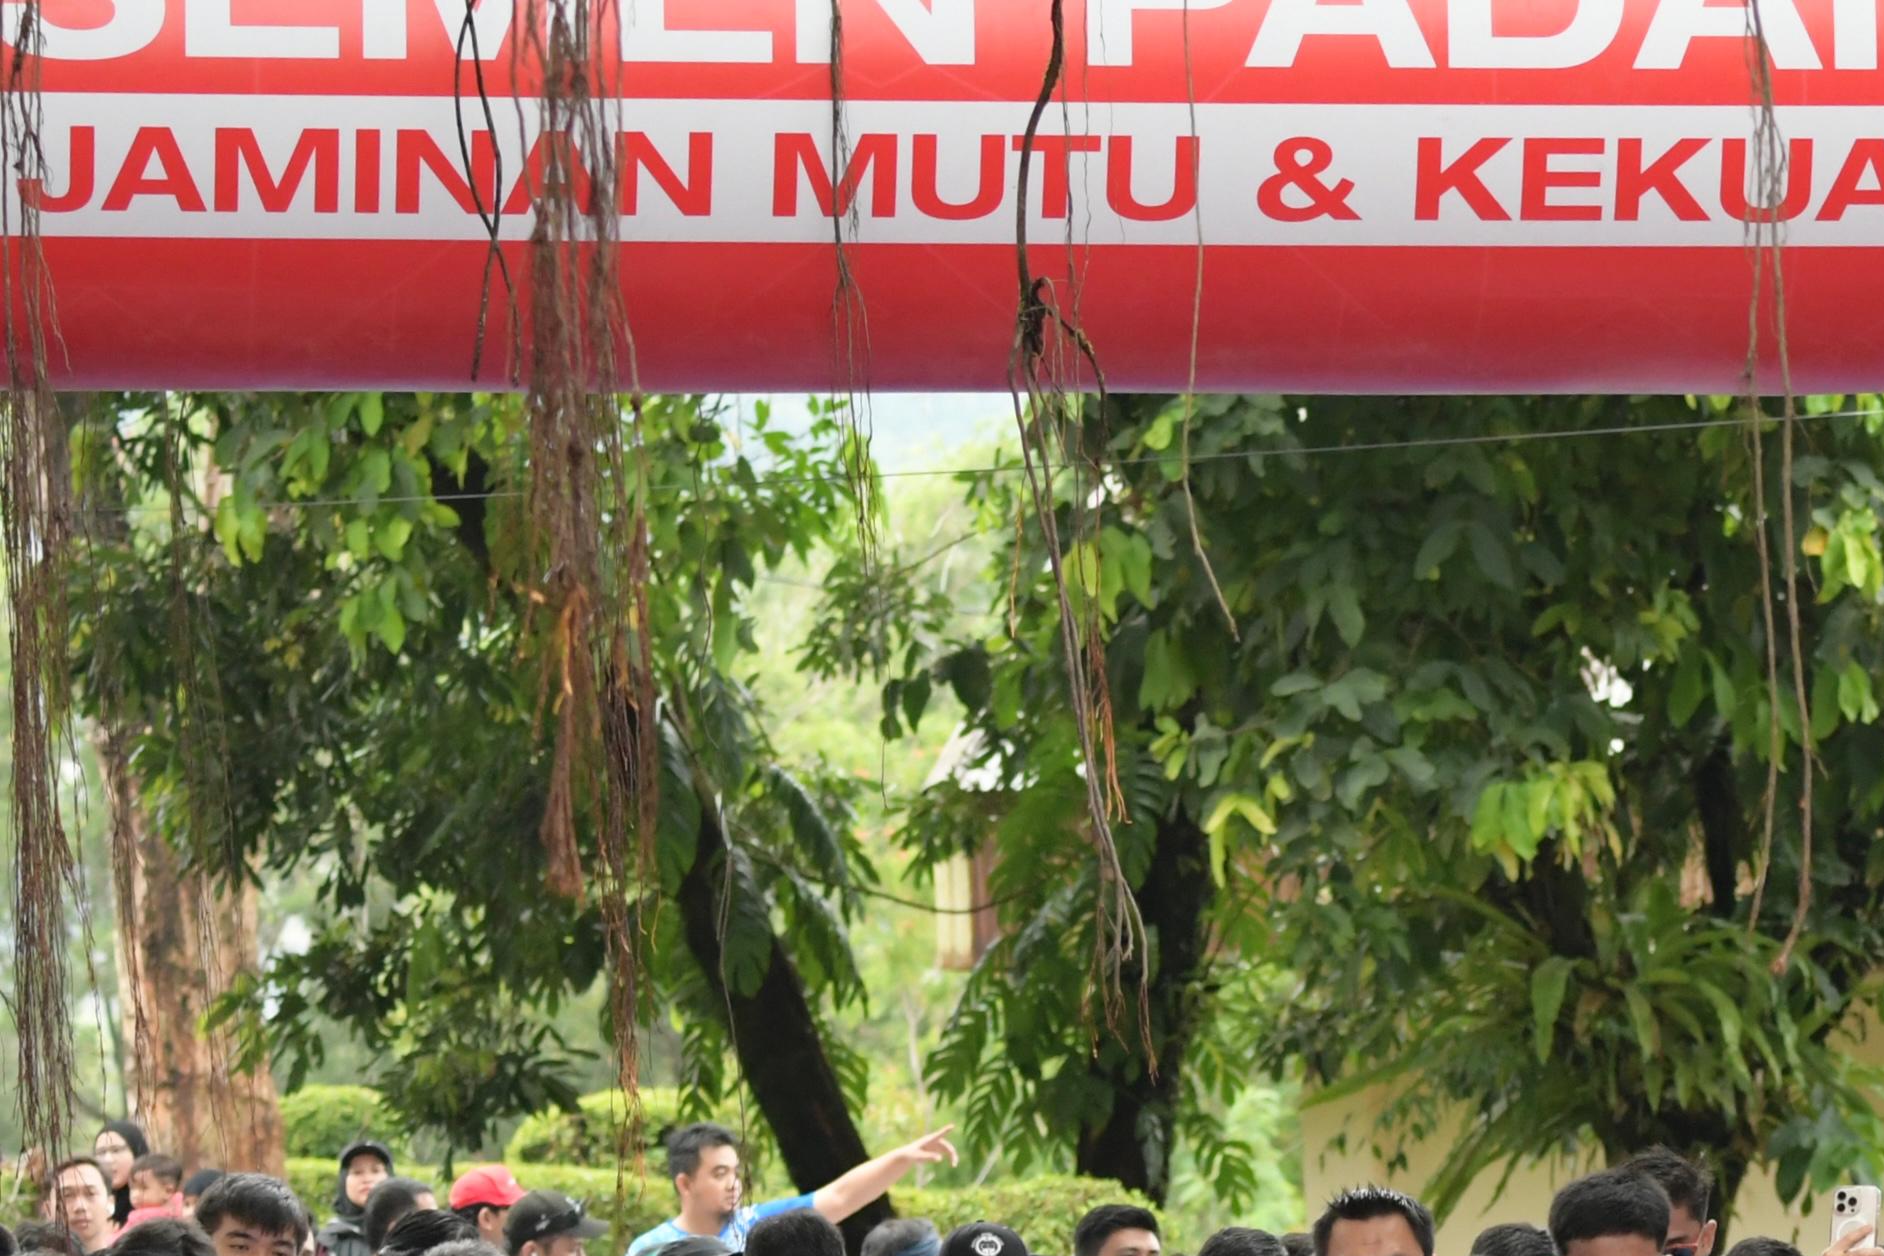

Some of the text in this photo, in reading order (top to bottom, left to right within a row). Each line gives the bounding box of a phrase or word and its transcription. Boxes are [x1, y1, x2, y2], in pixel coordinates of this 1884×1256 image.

[18, 125, 712, 219] JAMINAN
[773, 132, 1202, 222] MUTU
[1257, 135, 1362, 223] &
